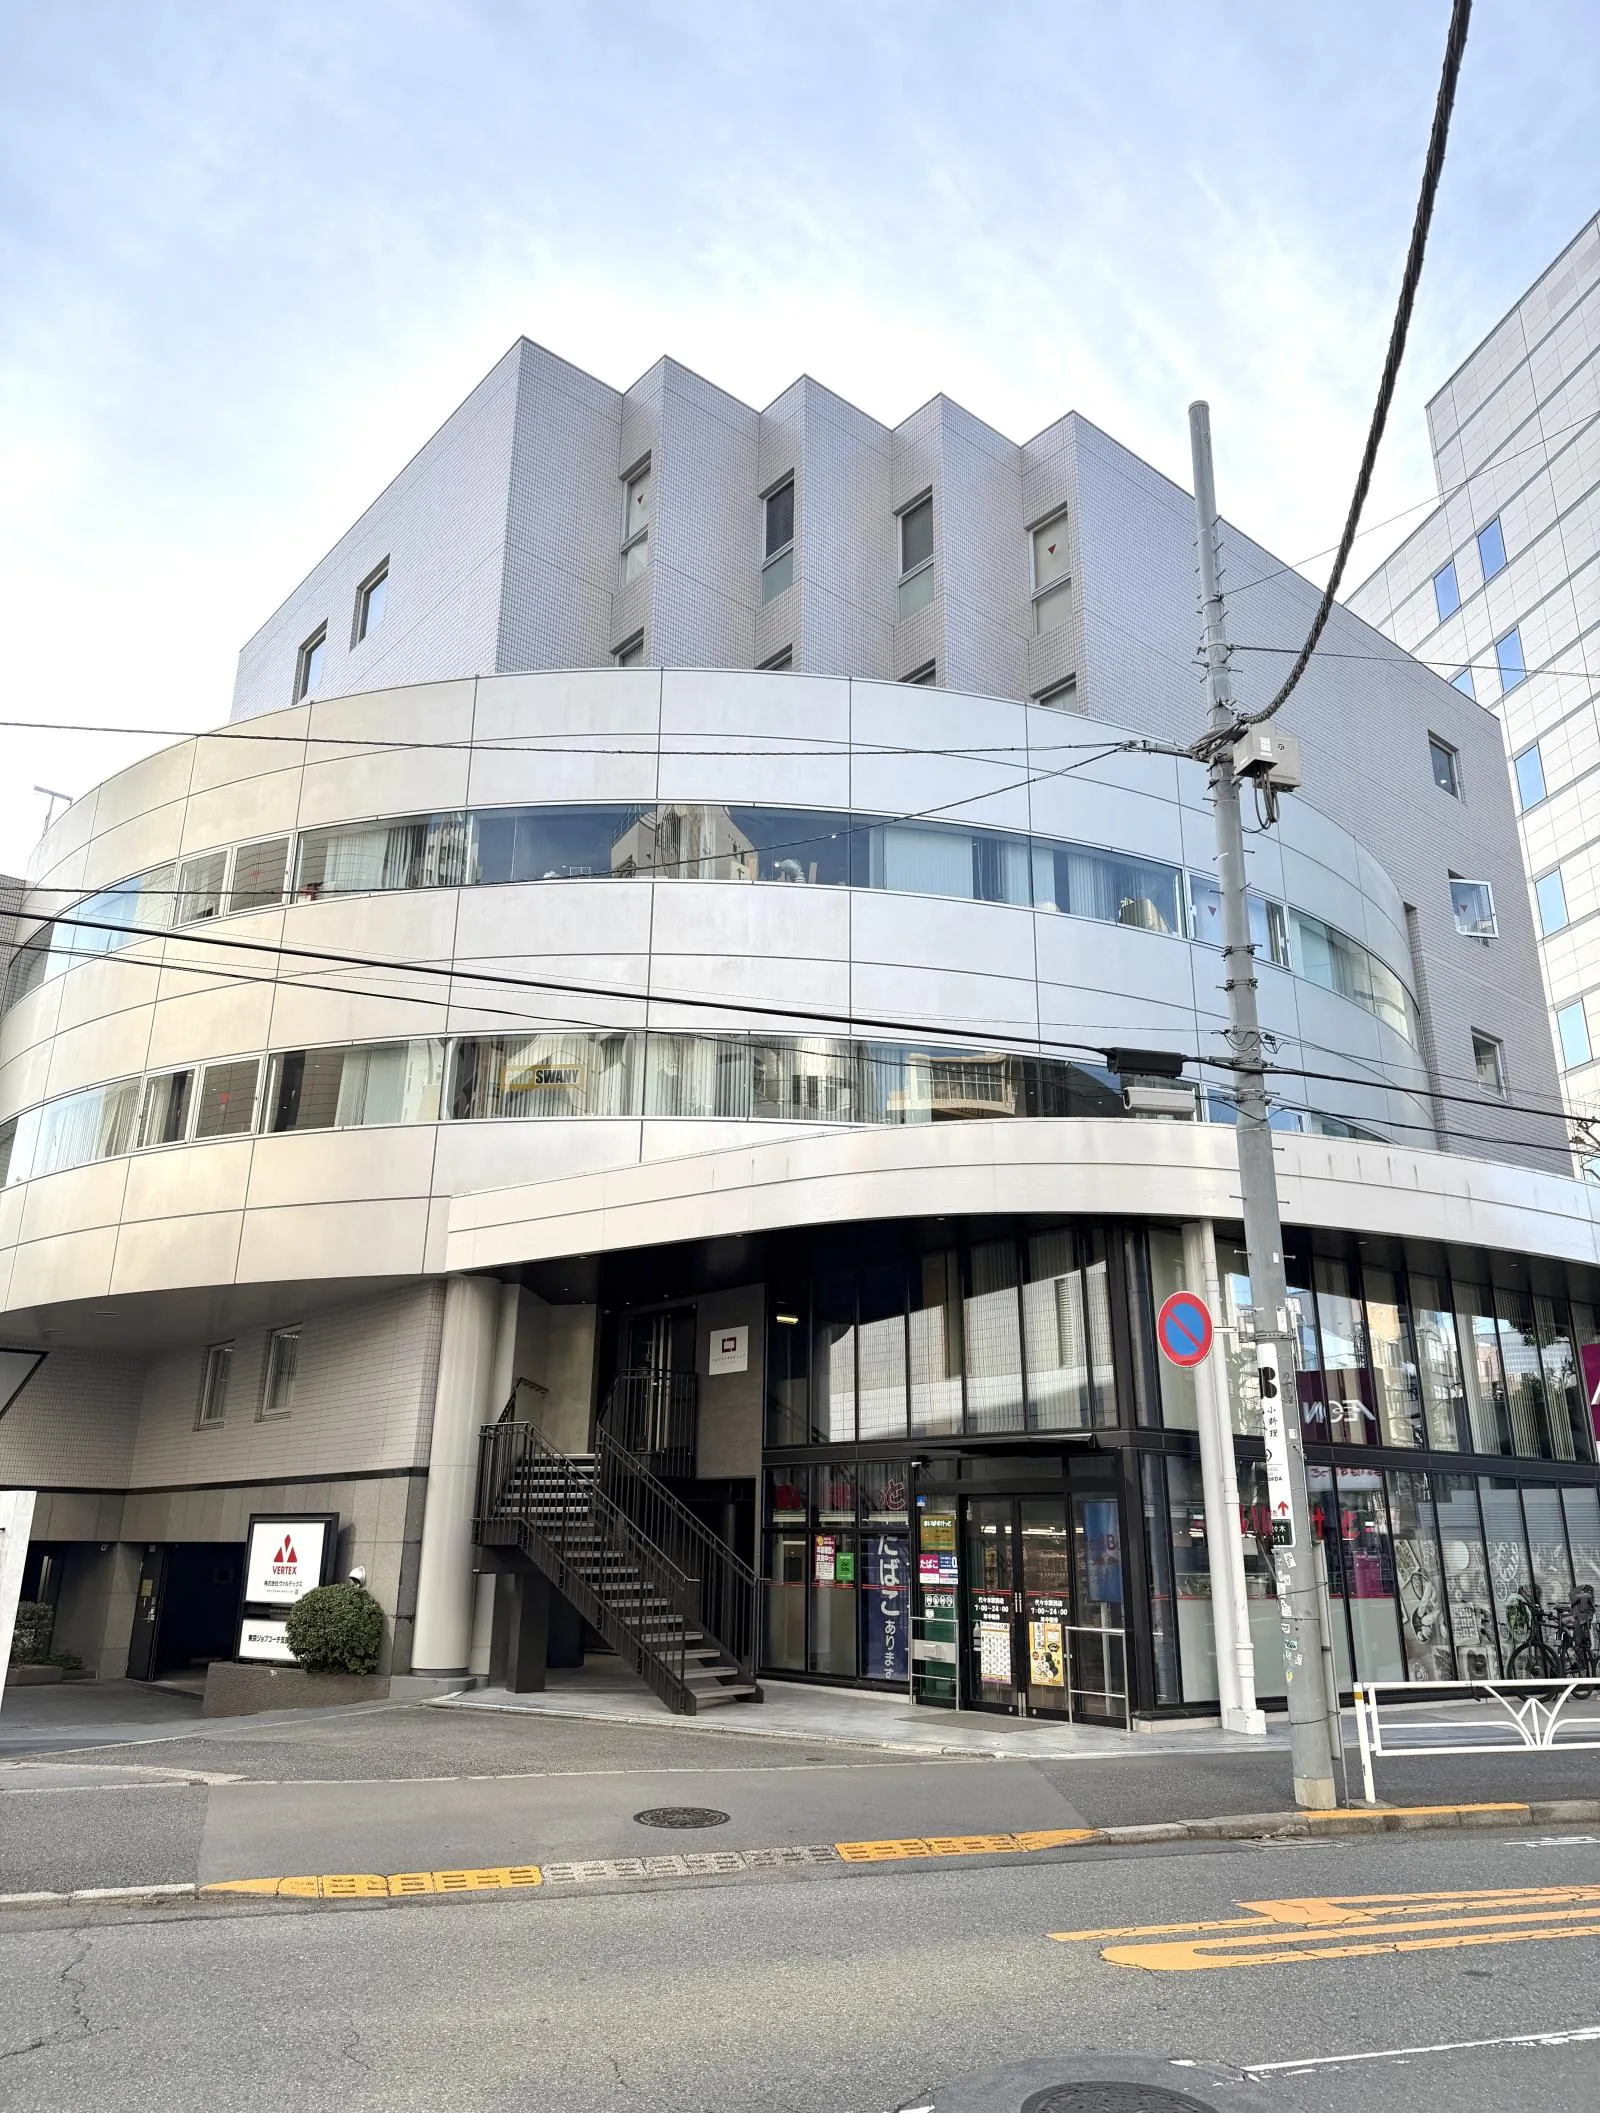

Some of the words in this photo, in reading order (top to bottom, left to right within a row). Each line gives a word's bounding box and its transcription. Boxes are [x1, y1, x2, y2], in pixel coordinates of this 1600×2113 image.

[535, 1069, 579, 1084] SWANY
[1267, 1405, 1279, 1438] 小料理
[272, 1565, 297, 1575] VERTEX
[920, 1559, 938, 1569] たばこ
